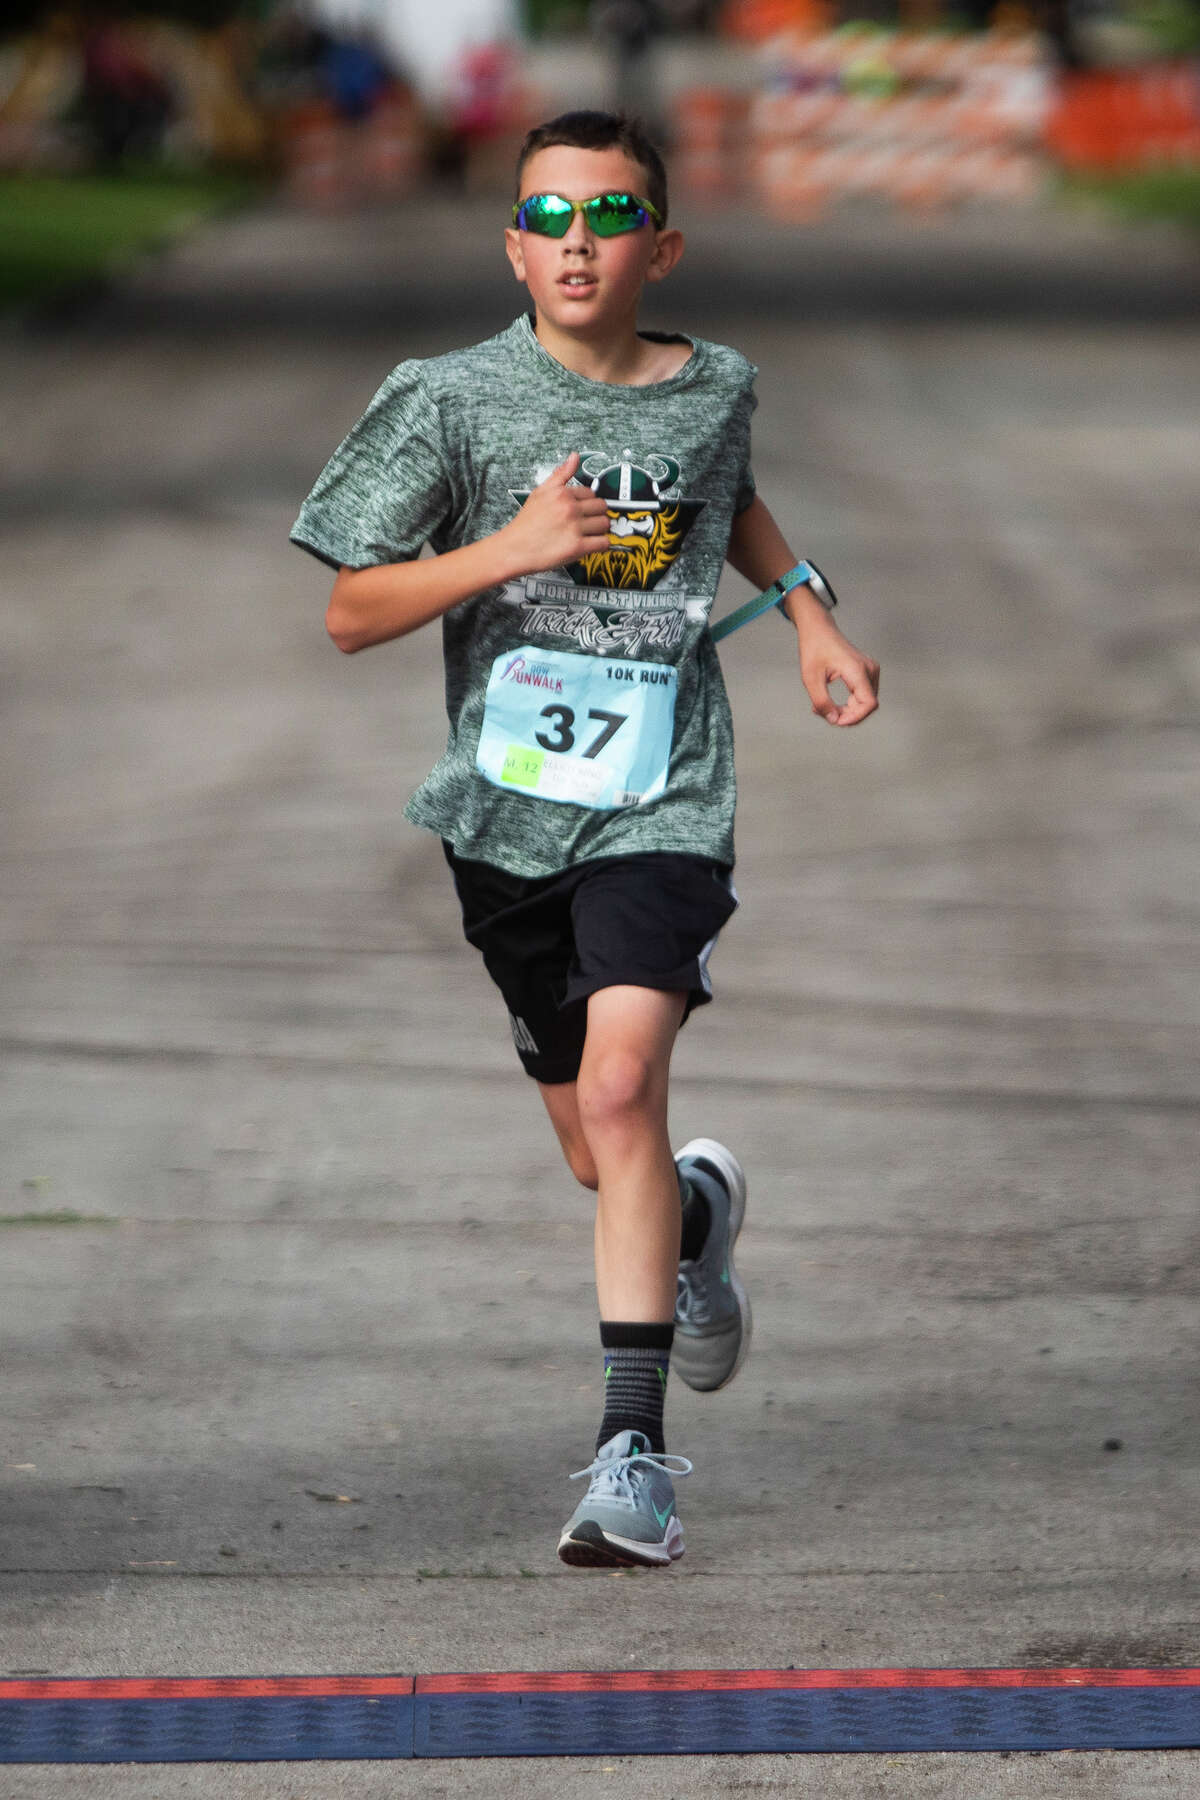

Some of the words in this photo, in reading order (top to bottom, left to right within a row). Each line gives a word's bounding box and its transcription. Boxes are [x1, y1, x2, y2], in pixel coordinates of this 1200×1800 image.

[536, 582, 630, 607] NORTHEAST
[632, 591, 680, 609] VIKINGS
[520, 600, 602, 649] Track
[624, 608, 687, 656] Field
[500, 658, 563, 691] RUNWALK
[606, 665, 635, 682] 10K
[640, 669, 669, 686] RUN
[535, 703, 629, 760] 37
[524, 761, 538, 774] 12
